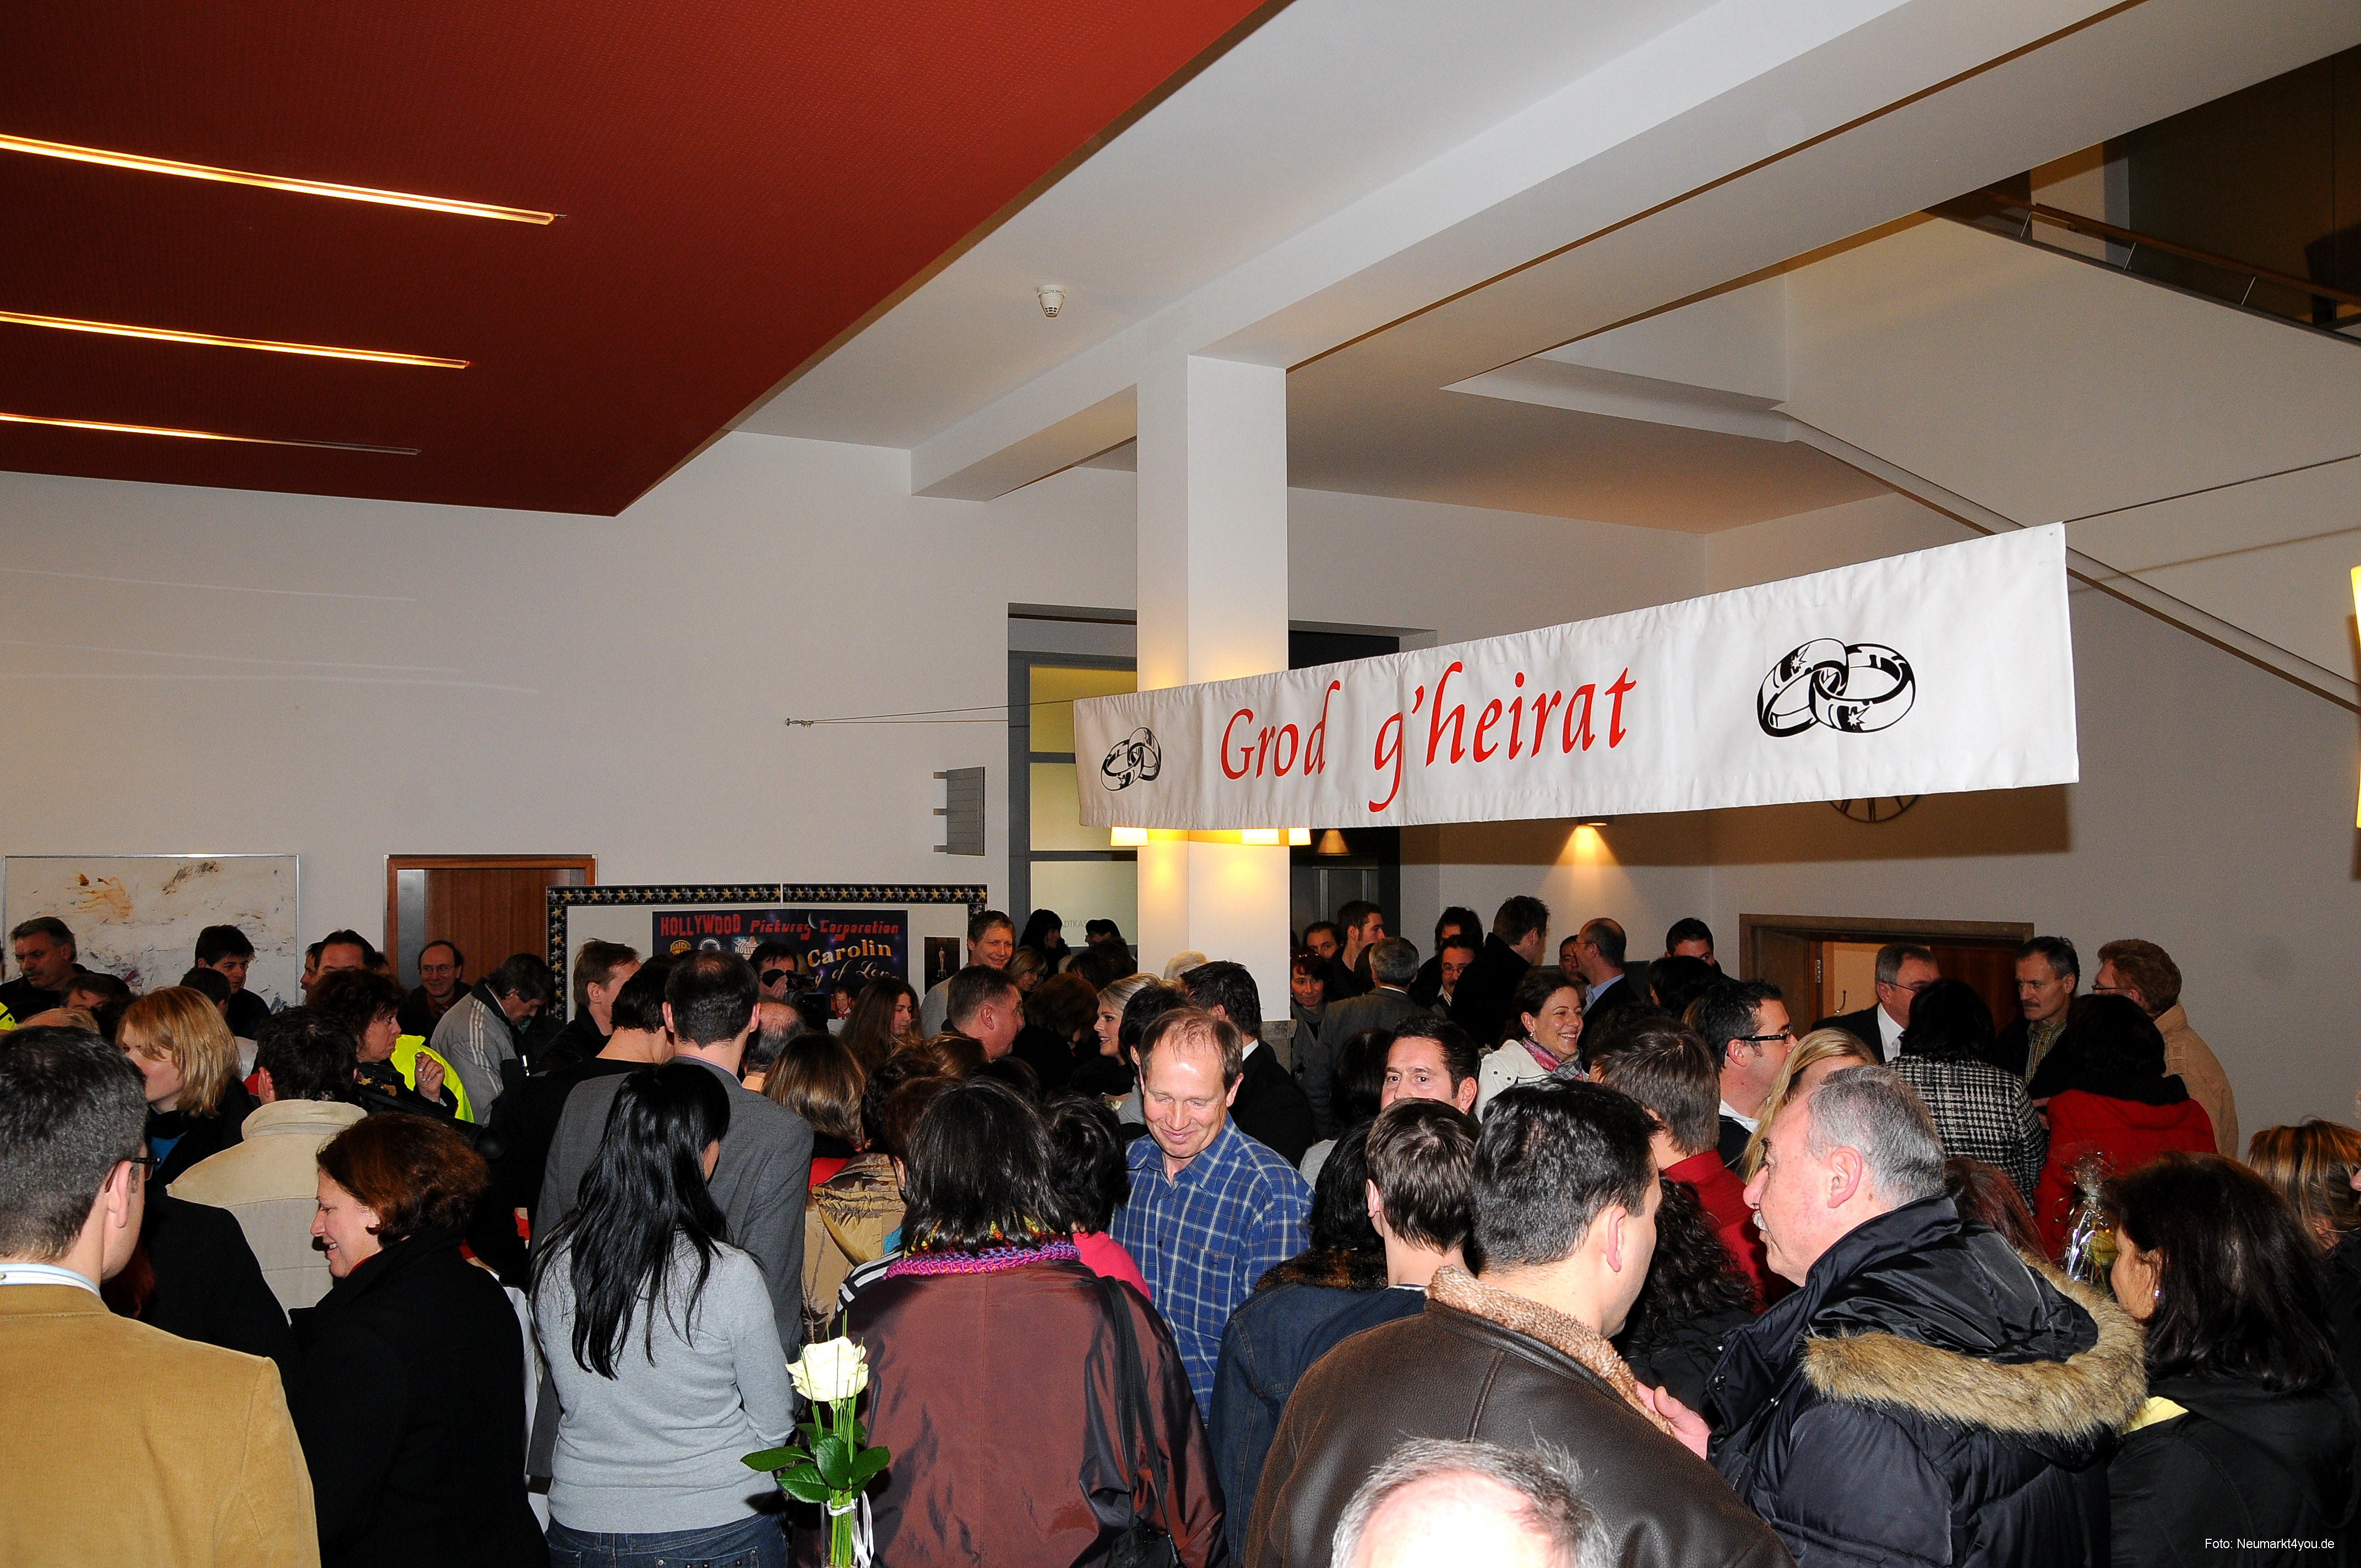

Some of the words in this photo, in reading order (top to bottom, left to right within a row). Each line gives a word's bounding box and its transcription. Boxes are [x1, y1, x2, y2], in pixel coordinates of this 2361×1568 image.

[1220, 679, 1341, 780] Grod
[661, 914, 741, 936] HOLLYWOOD
[750, 920, 811, 940] Pictures
[820, 920, 899, 941] Corporation
[807, 939, 892, 967] Carolin
[831, 960, 852, 982] of
[856, 960, 899, 980] Lov
